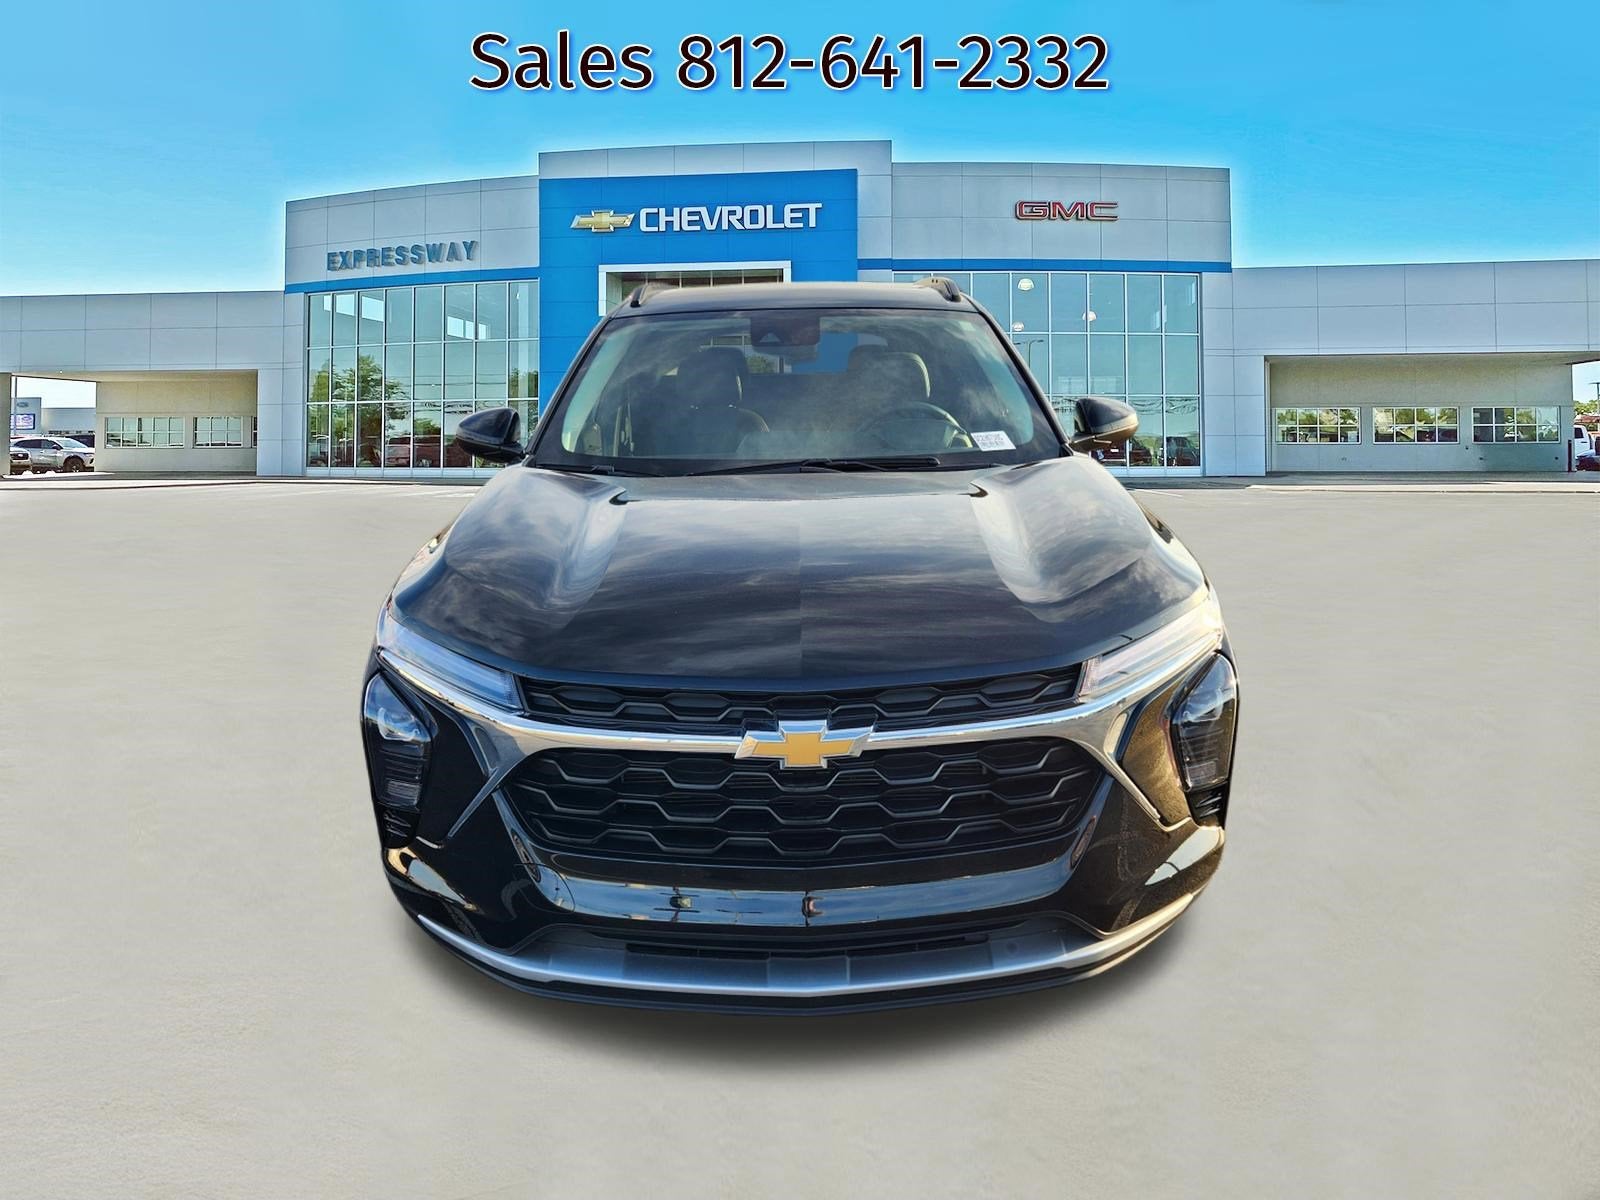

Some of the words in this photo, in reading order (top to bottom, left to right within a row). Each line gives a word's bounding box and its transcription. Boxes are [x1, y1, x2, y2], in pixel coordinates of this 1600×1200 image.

[639, 203, 823, 232] CHEVROLET
[1015, 201, 1119, 221] GMC
[327, 240, 479, 271] EXPRESSWAY
